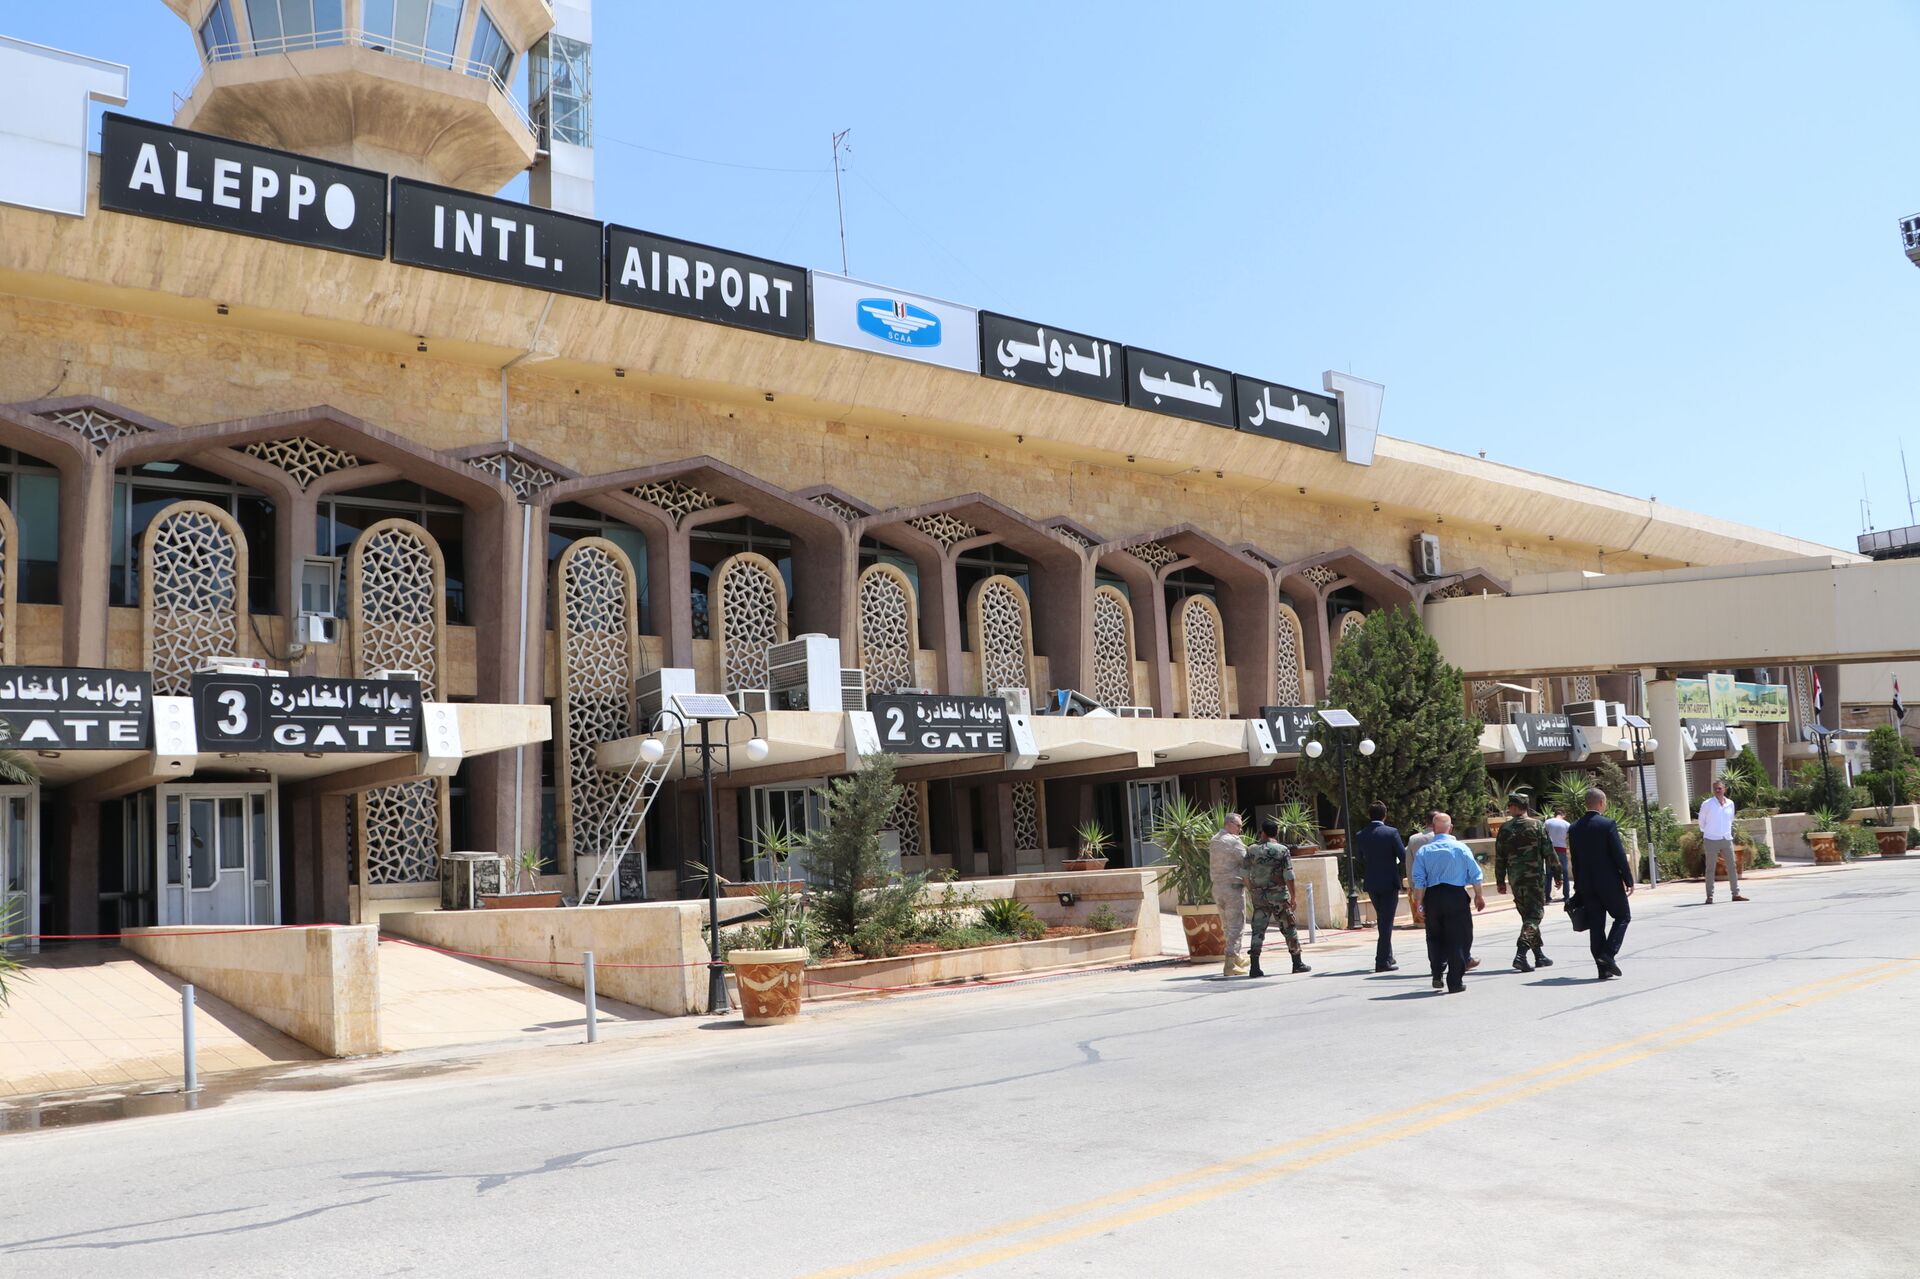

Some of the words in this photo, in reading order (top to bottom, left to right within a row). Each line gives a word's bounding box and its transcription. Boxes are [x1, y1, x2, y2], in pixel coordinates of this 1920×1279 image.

[128, 142, 356, 230] ALEPPO
[434, 205, 563, 272] INTL.
[620, 246, 793, 317] AIRPORT
[888, 331, 912, 343] SCAA
[997, 327, 1112, 378] الدولي
[1139, 366, 1223, 408] حلب
[1249, 387, 1330, 437] مطار
[0, 675, 69, 701] المغاد
[77, 676, 142, 707] بوابة
[270, 684, 352, 713] المغادرة
[359, 685, 413, 714] بوابة
[217, 689, 248, 735] 3
[886, 707, 907, 741] 2
[917, 702, 965, 723] المغادرة
[969, 702, 1002, 724] بوابة
[20, 719, 140, 741] ATE
[273, 724, 412, 746] GATE
[921, 732, 1004, 748] GATE
[1275, 715, 1287, 743] 1
[1522, 721, 1529, 743] 1
[1537, 736, 1571, 747] ARRIVAL
[1690, 725, 1698, 743] 2
[1702, 737, 1727, 747] ARRIVAL
